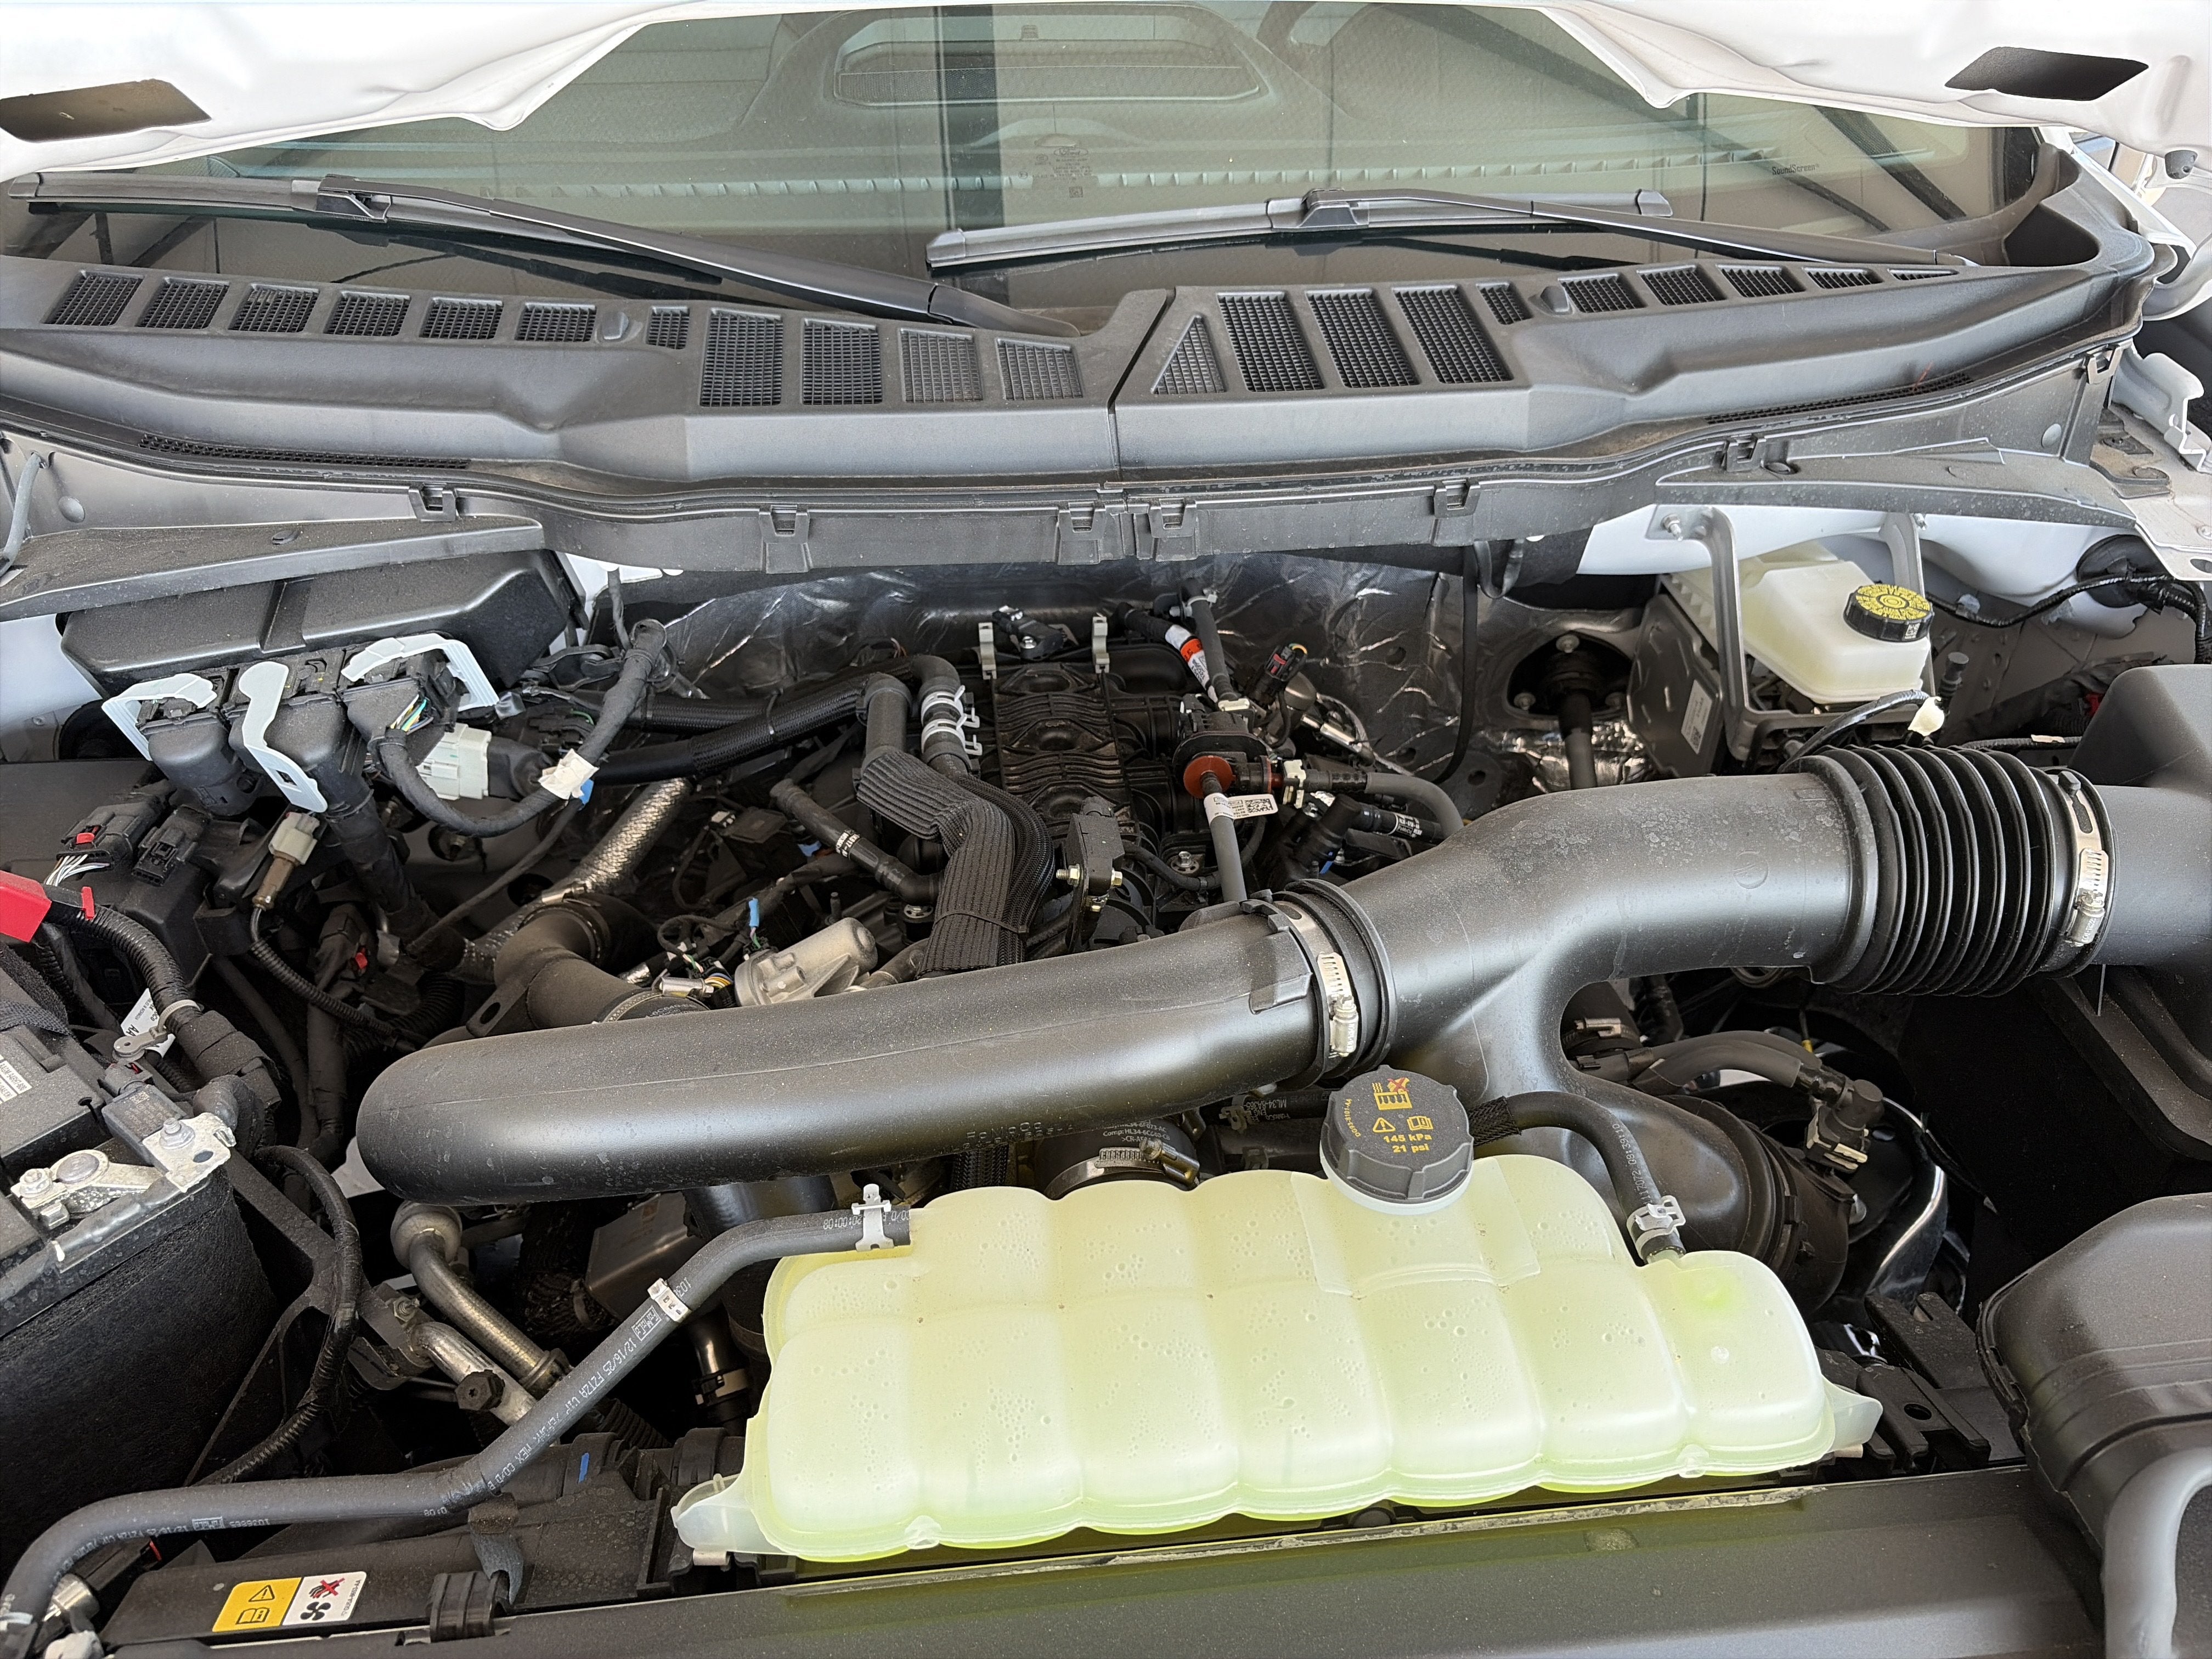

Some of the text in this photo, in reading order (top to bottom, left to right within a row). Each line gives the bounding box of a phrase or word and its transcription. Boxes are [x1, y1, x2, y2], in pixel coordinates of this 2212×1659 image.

[1383, 1133, 1432, 1143] 145 kPa
[1392, 1143, 1430, 1153] 21 psi
[603, 1338, 637, 1375] 12/16/25
[515, 1443, 532, 1464] MEX
